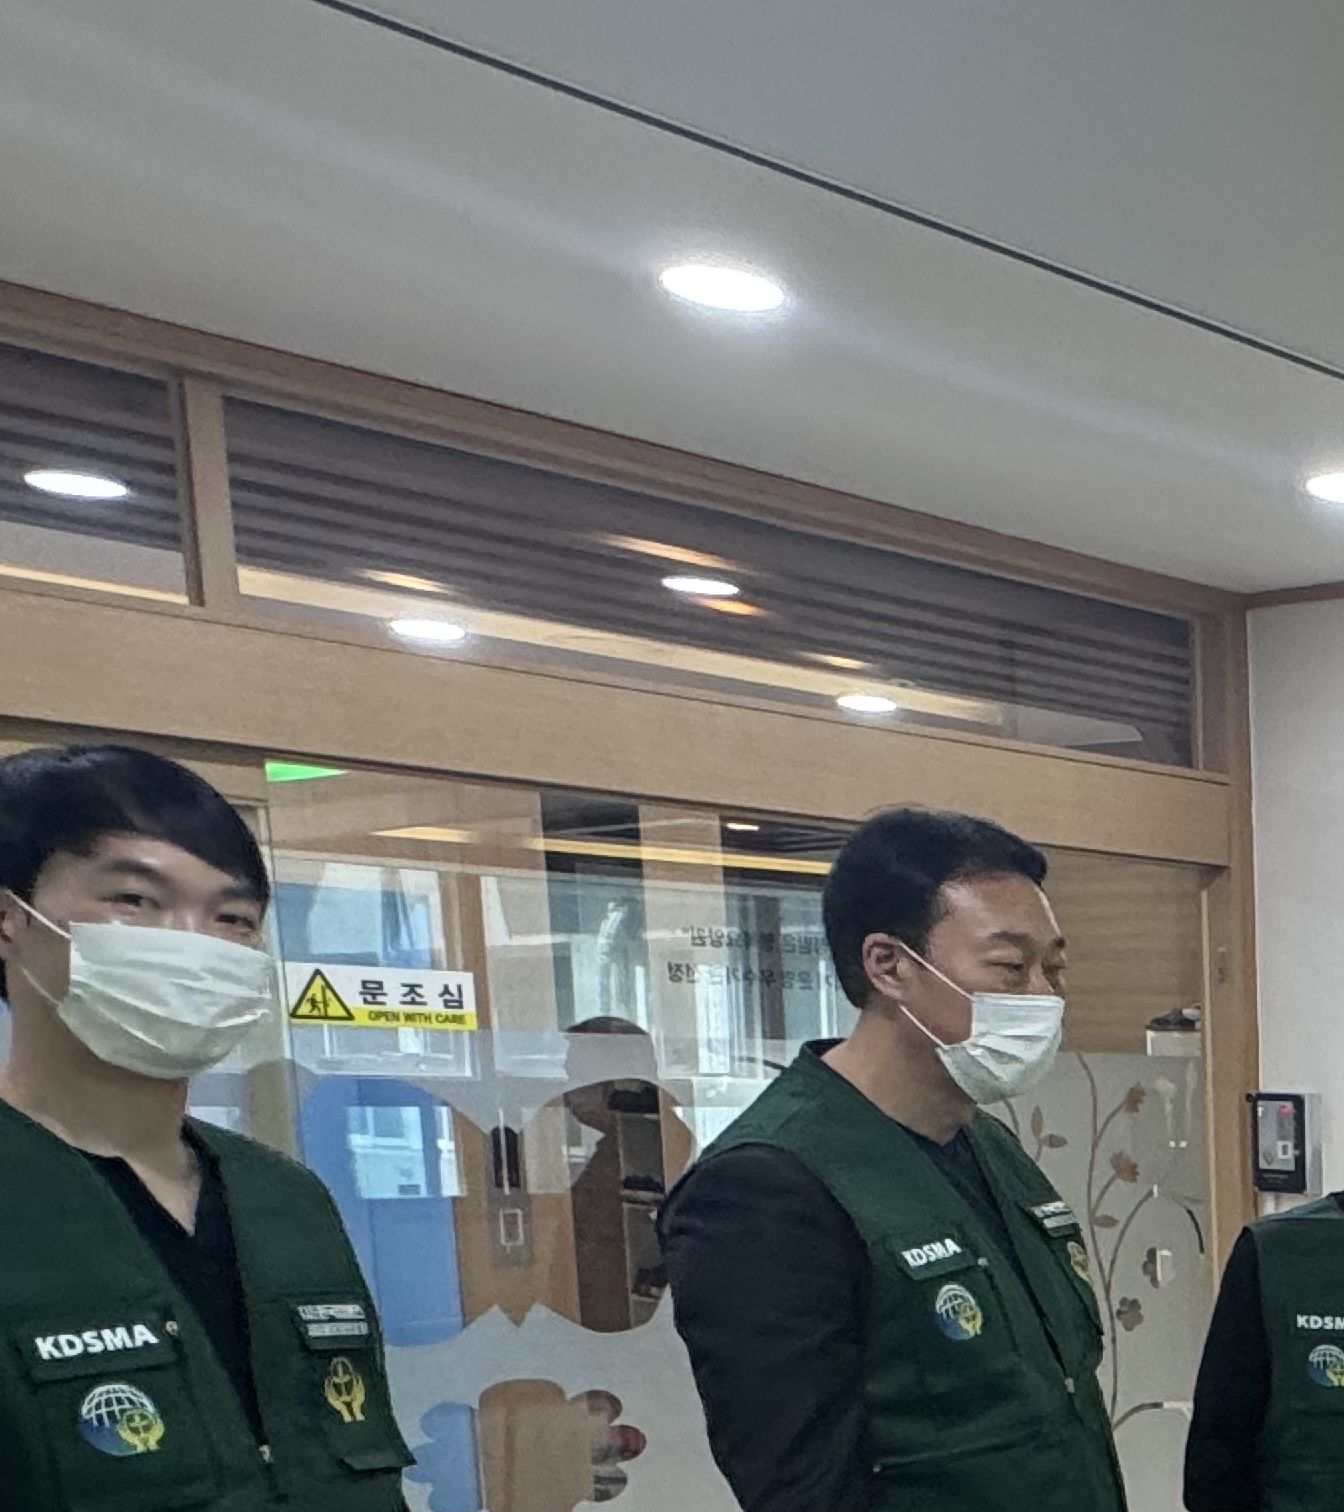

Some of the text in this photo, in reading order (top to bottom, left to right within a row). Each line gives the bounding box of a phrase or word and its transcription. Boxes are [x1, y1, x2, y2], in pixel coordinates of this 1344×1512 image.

[358, 980, 465, 1010] 문조심
[367, 1010, 466, 1025] OPEN WITH CARE
[34, 1324, 159, 1360] KDSMA
